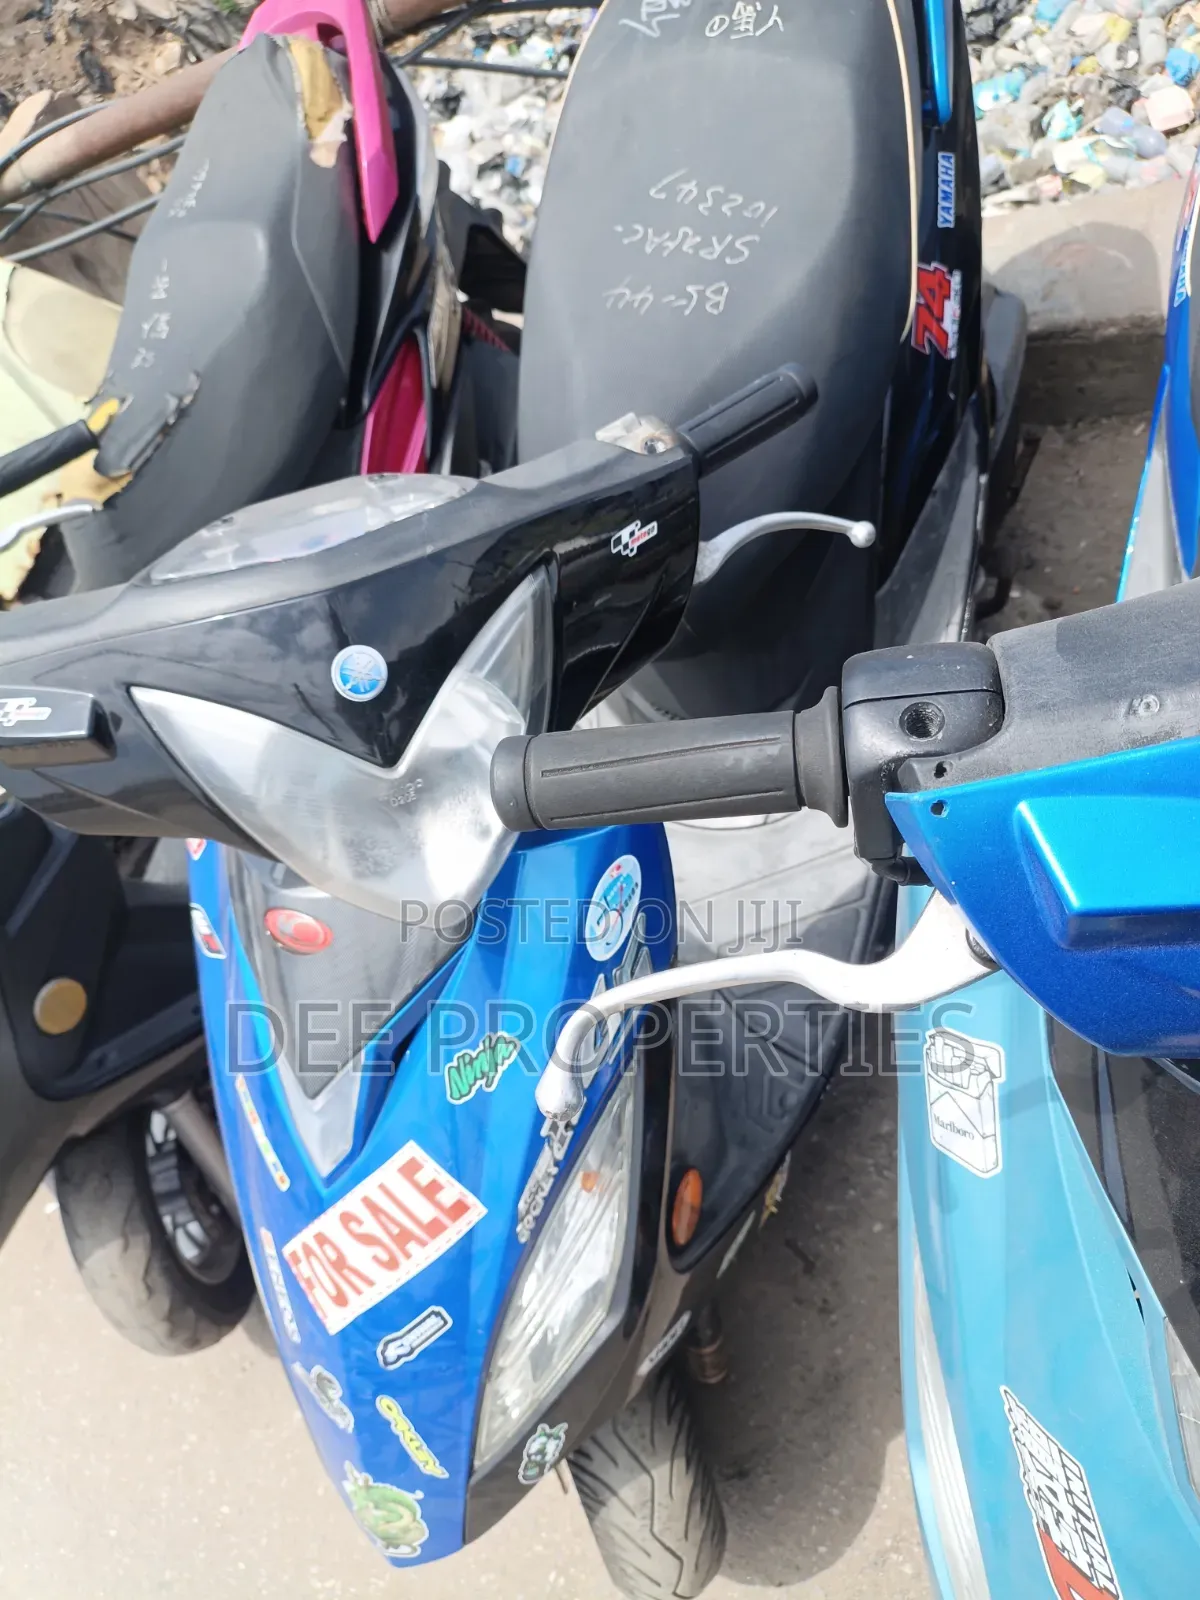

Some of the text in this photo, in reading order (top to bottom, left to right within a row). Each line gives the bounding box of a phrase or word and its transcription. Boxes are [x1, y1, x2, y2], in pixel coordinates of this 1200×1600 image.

[939, 153, 954, 226] YAMAHA
[914, 264, 952, 357] 74
[446, 1033, 519, 1103] Ninja
[933, 1112, 975, 1141] Marlboro
[288, 1231, 376, 1322] FOR
[339, 1155, 471, 1272] SALE
[1058, 1449, 1120, 1600] INITIAL
